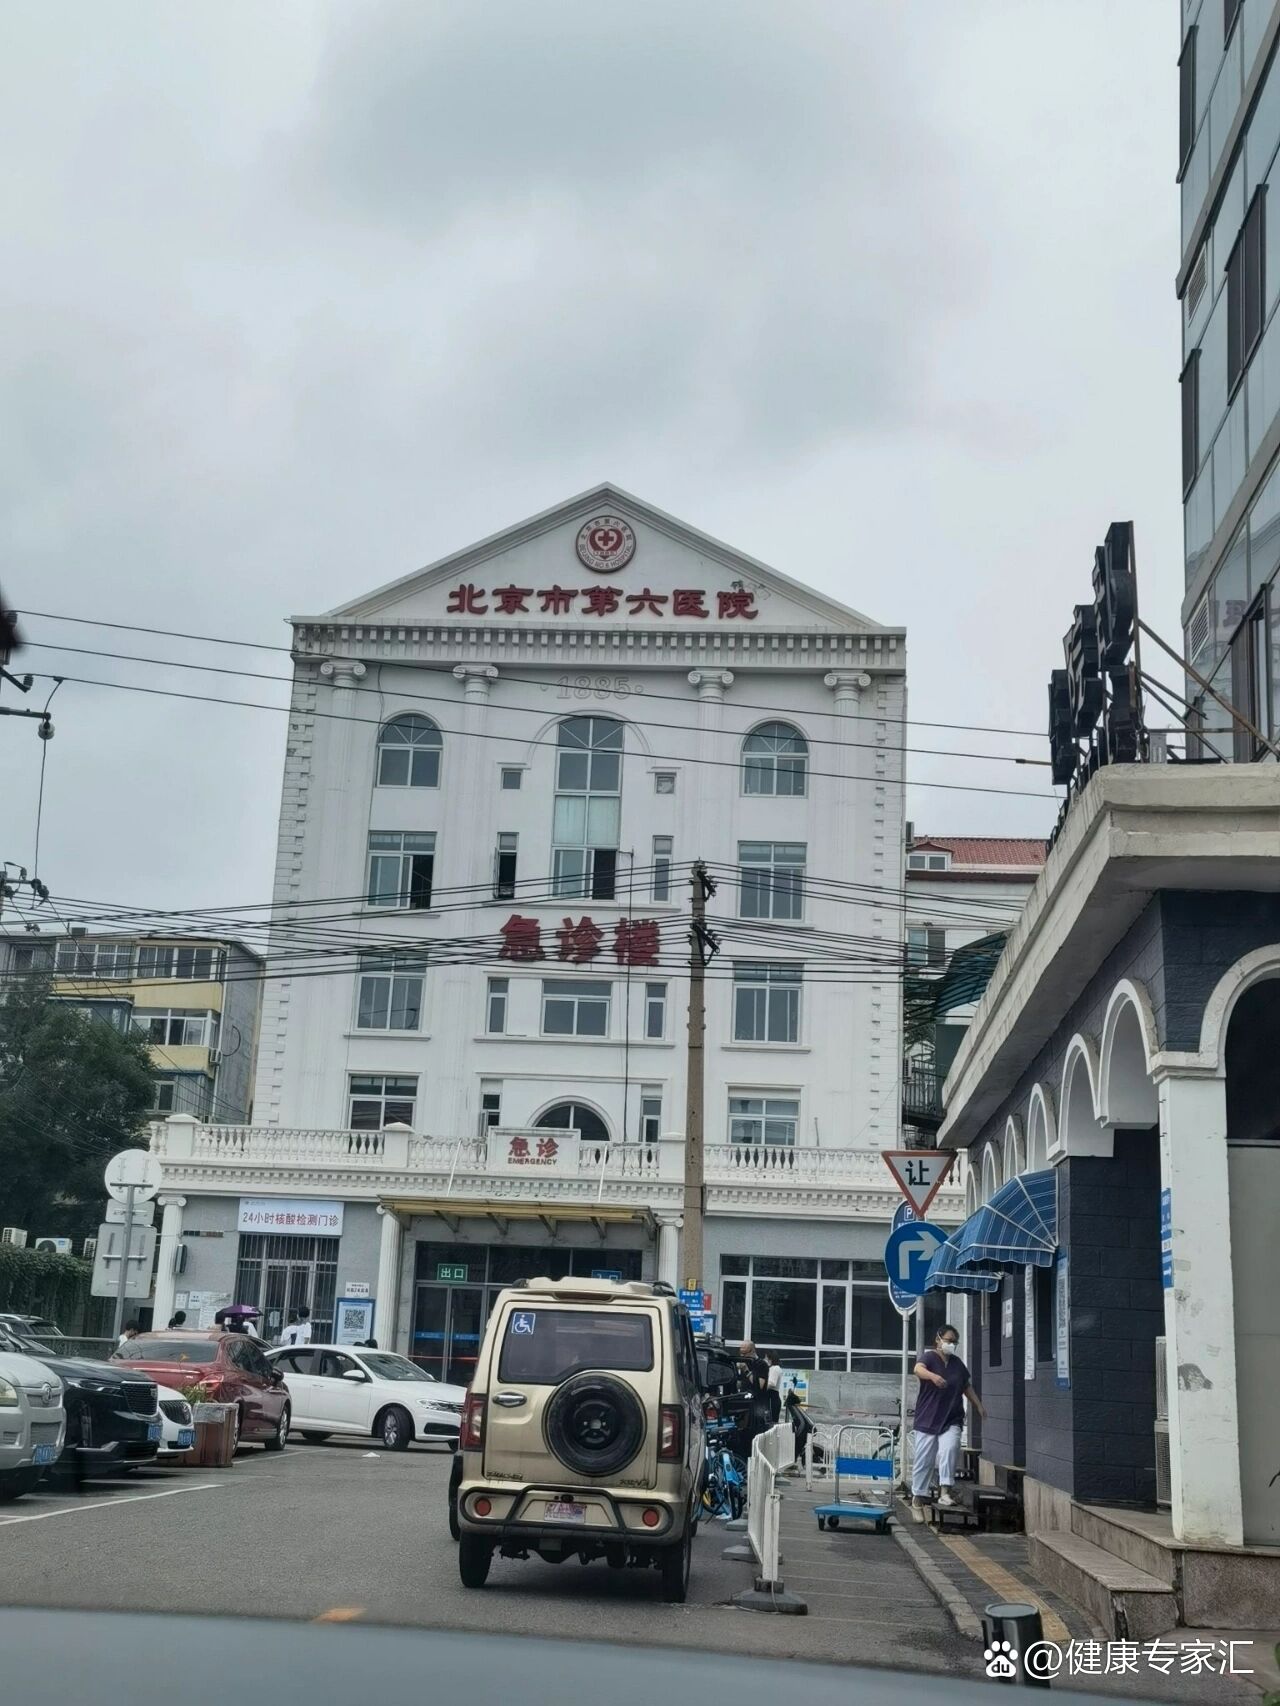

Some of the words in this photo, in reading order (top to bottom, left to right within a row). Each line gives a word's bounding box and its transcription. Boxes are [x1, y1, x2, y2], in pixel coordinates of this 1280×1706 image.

[447, 583, 758, 619] 北京市第六医院
[555, 675, 631, 700] 1885
[499, 914, 660, 966] 急诊楼
[508, 1136, 559, 1158] 急诊
[507, 1157, 558, 1166] EMERGENCY
[905, 1160, 931, 1186] 让
[243, 1211, 340, 1227] 24小时核酸检测门诊
[440, 1267, 464, 1279] 出口
